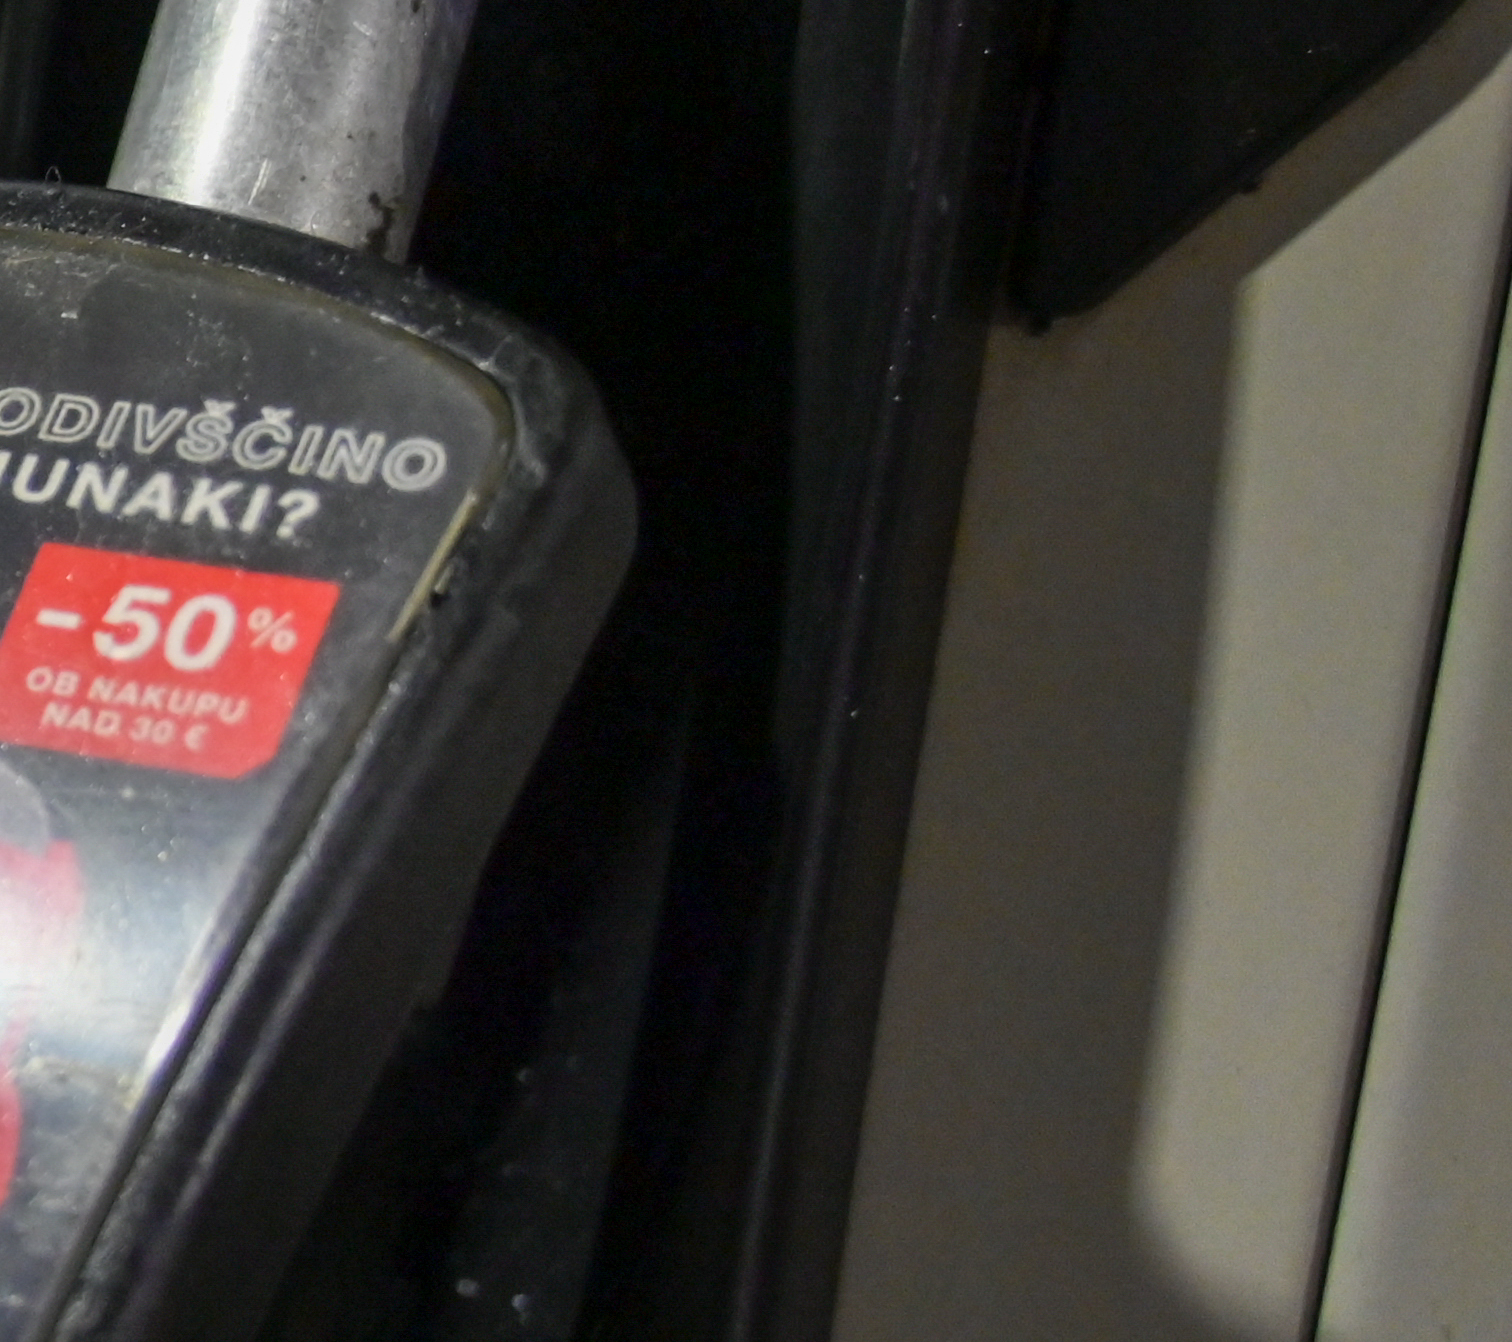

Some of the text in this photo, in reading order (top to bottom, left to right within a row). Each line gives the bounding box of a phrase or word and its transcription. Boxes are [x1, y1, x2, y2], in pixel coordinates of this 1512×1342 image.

[25, 666, 250, 725] OB NAKUPU
[40, 702, 123, 738] NAD
[131, 716, 177, 746] 30
